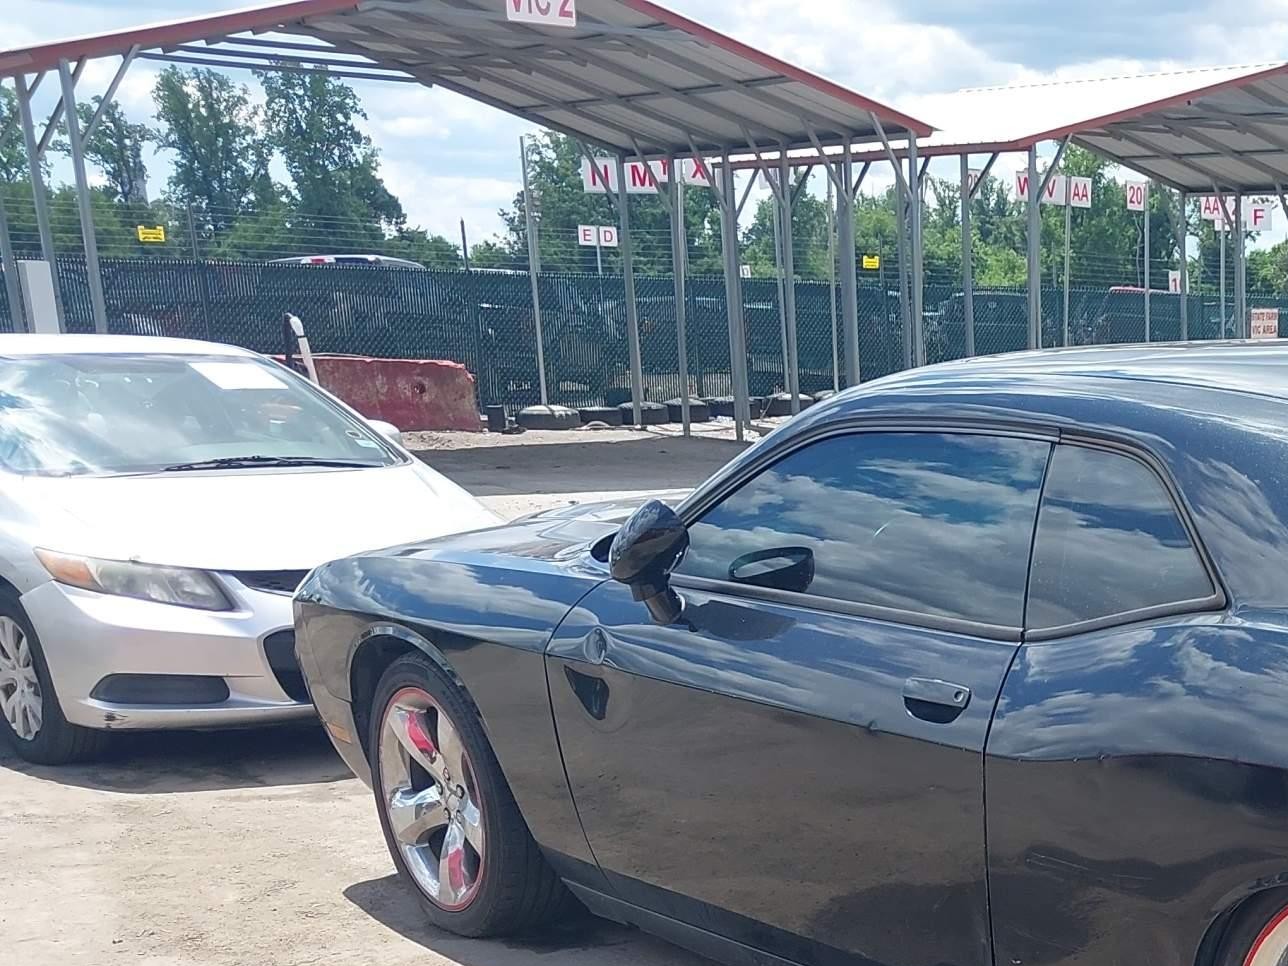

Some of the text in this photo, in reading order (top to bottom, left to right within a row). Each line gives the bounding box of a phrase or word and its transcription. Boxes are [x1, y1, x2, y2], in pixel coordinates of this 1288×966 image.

[1072, 183, 1089, 202] AA
[1129, 186, 1142, 205] 20
[1203, 196, 1220, 215] AA
[1254, 209, 1264, 225] F
[583, 229, 592, 242] E
[603, 230, 613, 243] D
